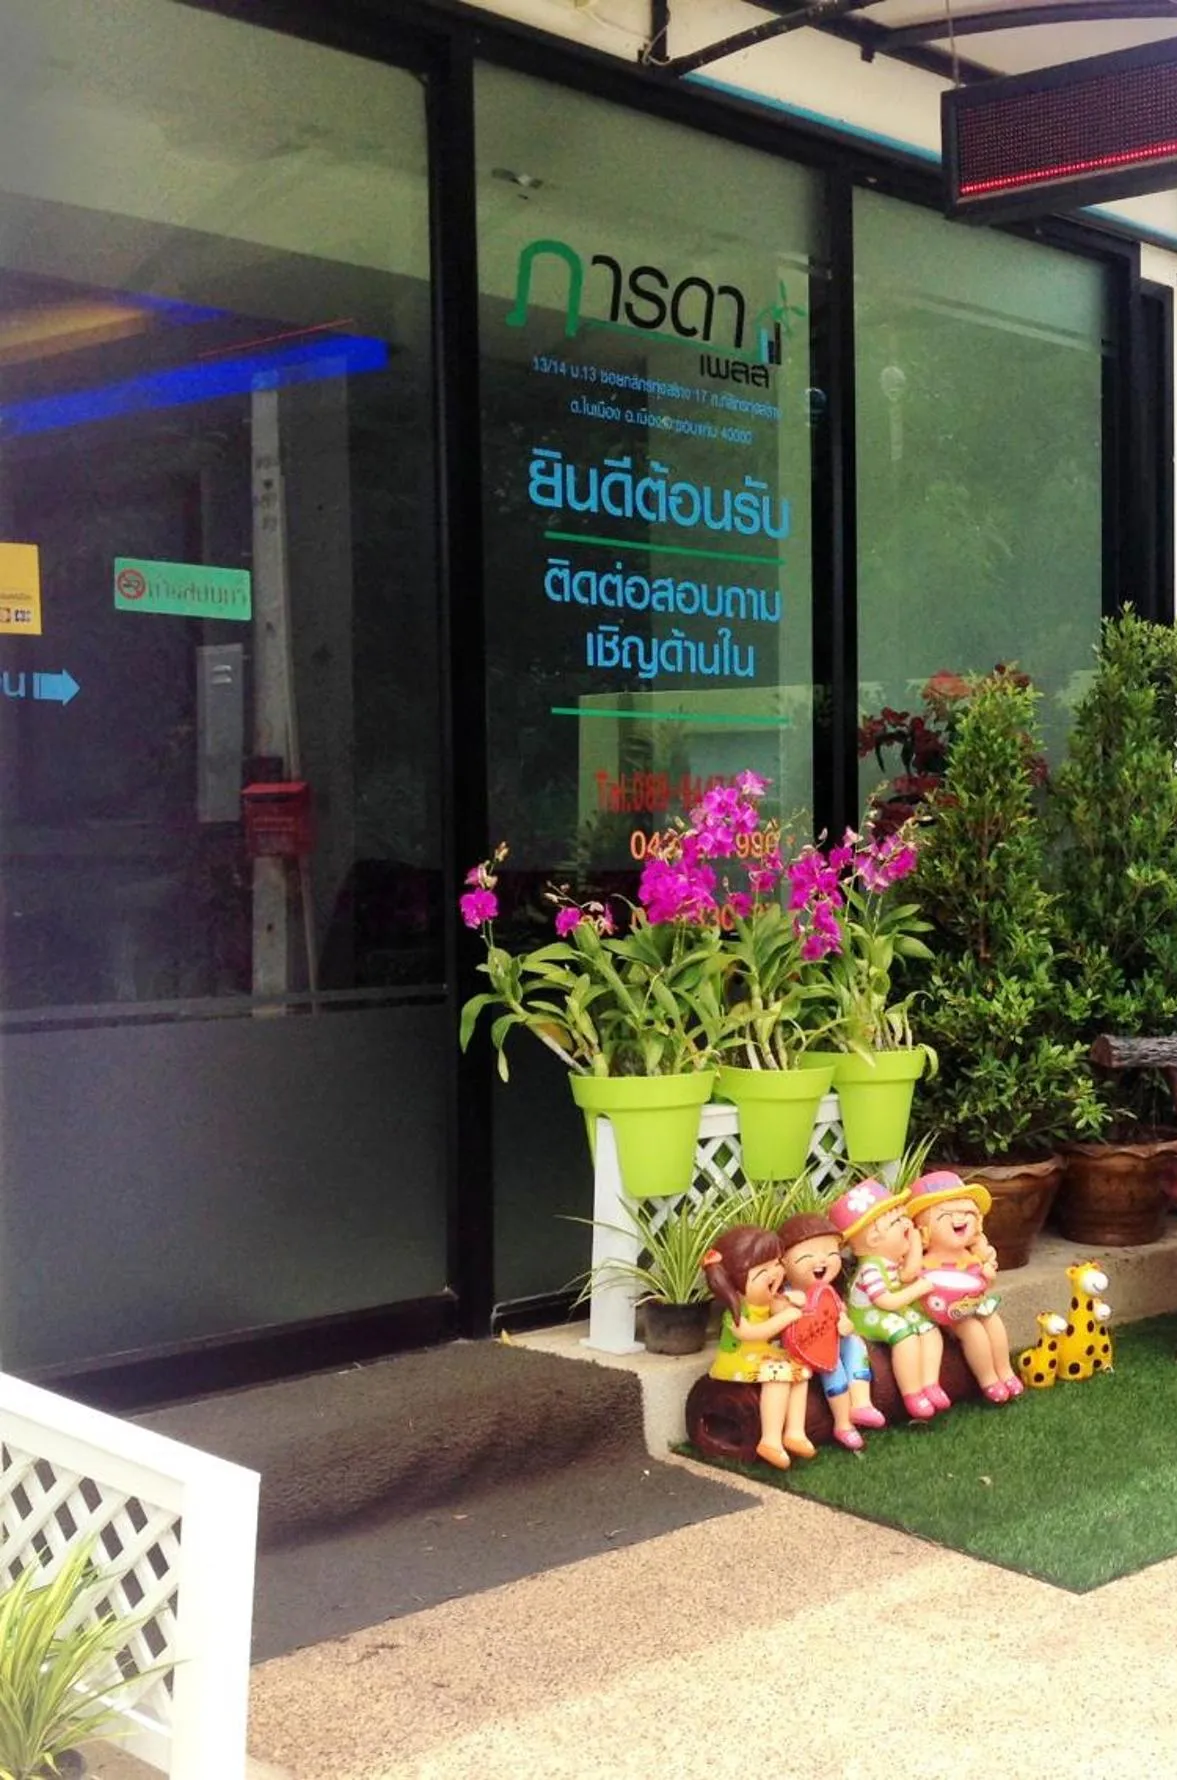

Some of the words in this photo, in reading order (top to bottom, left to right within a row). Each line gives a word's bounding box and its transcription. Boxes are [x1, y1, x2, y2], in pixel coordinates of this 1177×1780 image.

[528, 448, 791, 539] ยินดีต้อนรับ
[544, 558, 783, 623] ติดต่อสอบถาม
[586, 625, 755, 679] เชิญด้านใน
